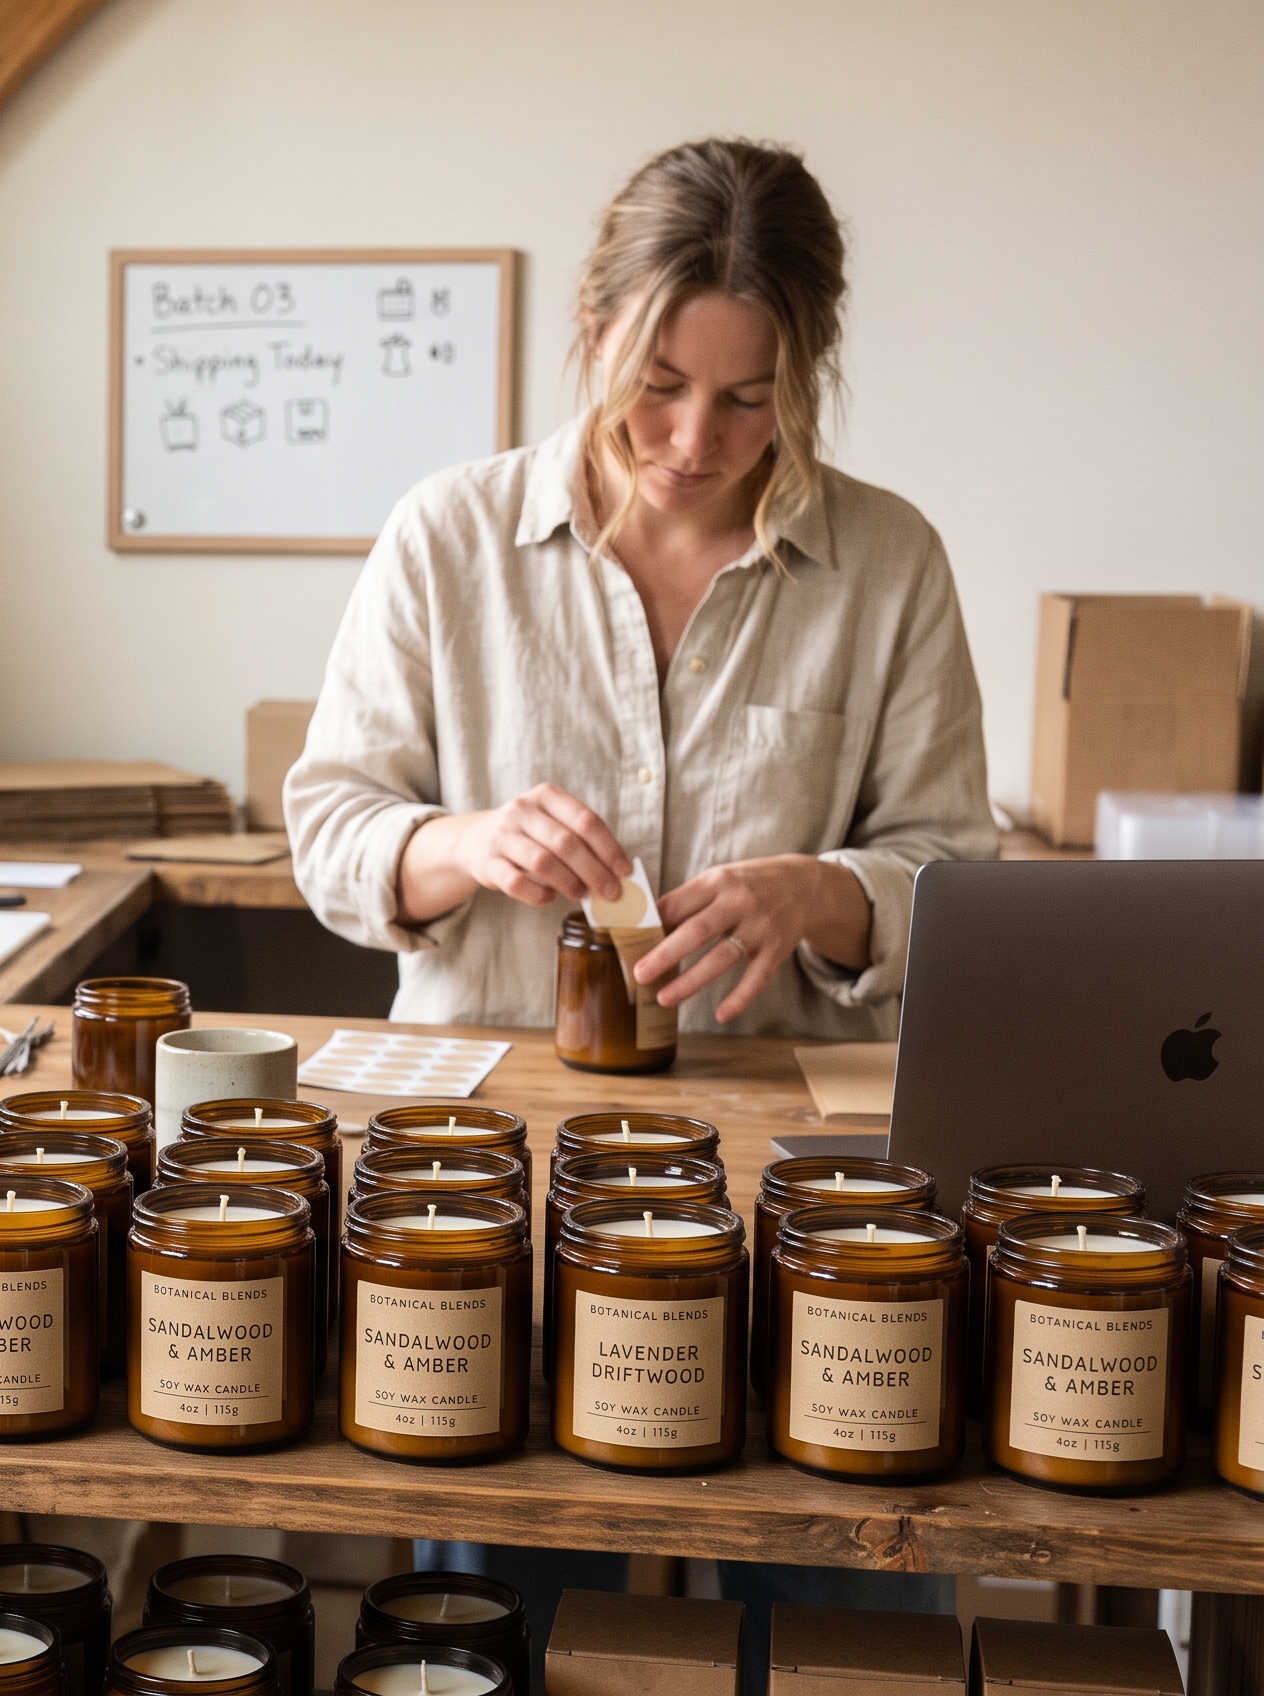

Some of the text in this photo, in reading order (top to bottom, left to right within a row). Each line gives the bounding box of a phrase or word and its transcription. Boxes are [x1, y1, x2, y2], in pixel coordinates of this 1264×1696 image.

[151, 281, 295, 319] Batch 03
[151, 340, 343, 387] Shipping Today
[2, 1281, 46, 1291] BLENDS
[154, 1285, 266, 1300] BOTANICAL BLENDS
[371, 1294, 485, 1310] BOTANICAL BLENDS
[591, 1305, 707, 1321] BOTANICAL BLENDS
[808, 1306, 927, 1323] BOTANICAL BLENDS
[149, 1318, 272, 1340] SANDALWOOD
[1030, 1314, 1152, 1331] BOTANICAL BLENDS
[365, 1328, 490, 1350] SANDALWOOD
[169, 1344, 251, 1362] & AMBER
[600, 1342, 698, 1361] LAVENDER
[801, 1340, 931, 1364] SANDALWOOD
[384, 1354, 468, 1373] & AMBER
[1023, 1348, 1156, 1373] SANDALWOOD
[593, 1363, 704, 1384] DRIFTWOOD
[822, 1367, 909, 1387] & AMBER
[160, 1379, 259, 1394] SOY WAX CANDLE
[1045, 1376, 1133, 1395] & AMBER
[376, 1390, 477, 1404] SOY WAX CANDLE
[180, 1404, 198, 1413] 4oz
[215, 1405, 238, 1416] 115g
[595, 1401, 699, 1416] SOY WAX CANDLE
[812, 1403, 917, 1419] SOY WAX CANDLE
[396, 1414, 415, 1424] 4oz
[431, 1416, 455, 1427] 115g
[1034, 1412, 1142, 1428] SOY WAX CANDLE
[617, 1426, 636, 1435] 4oz
[653, 1428, 677, 1439] 115g
[833, 1428, 854, 1438] 4oz
[871, 1431, 895, 1443] 115g
[1057, 1438, 1077, 1448] 4oz
[1094, 1440, 1119, 1452] 115g
